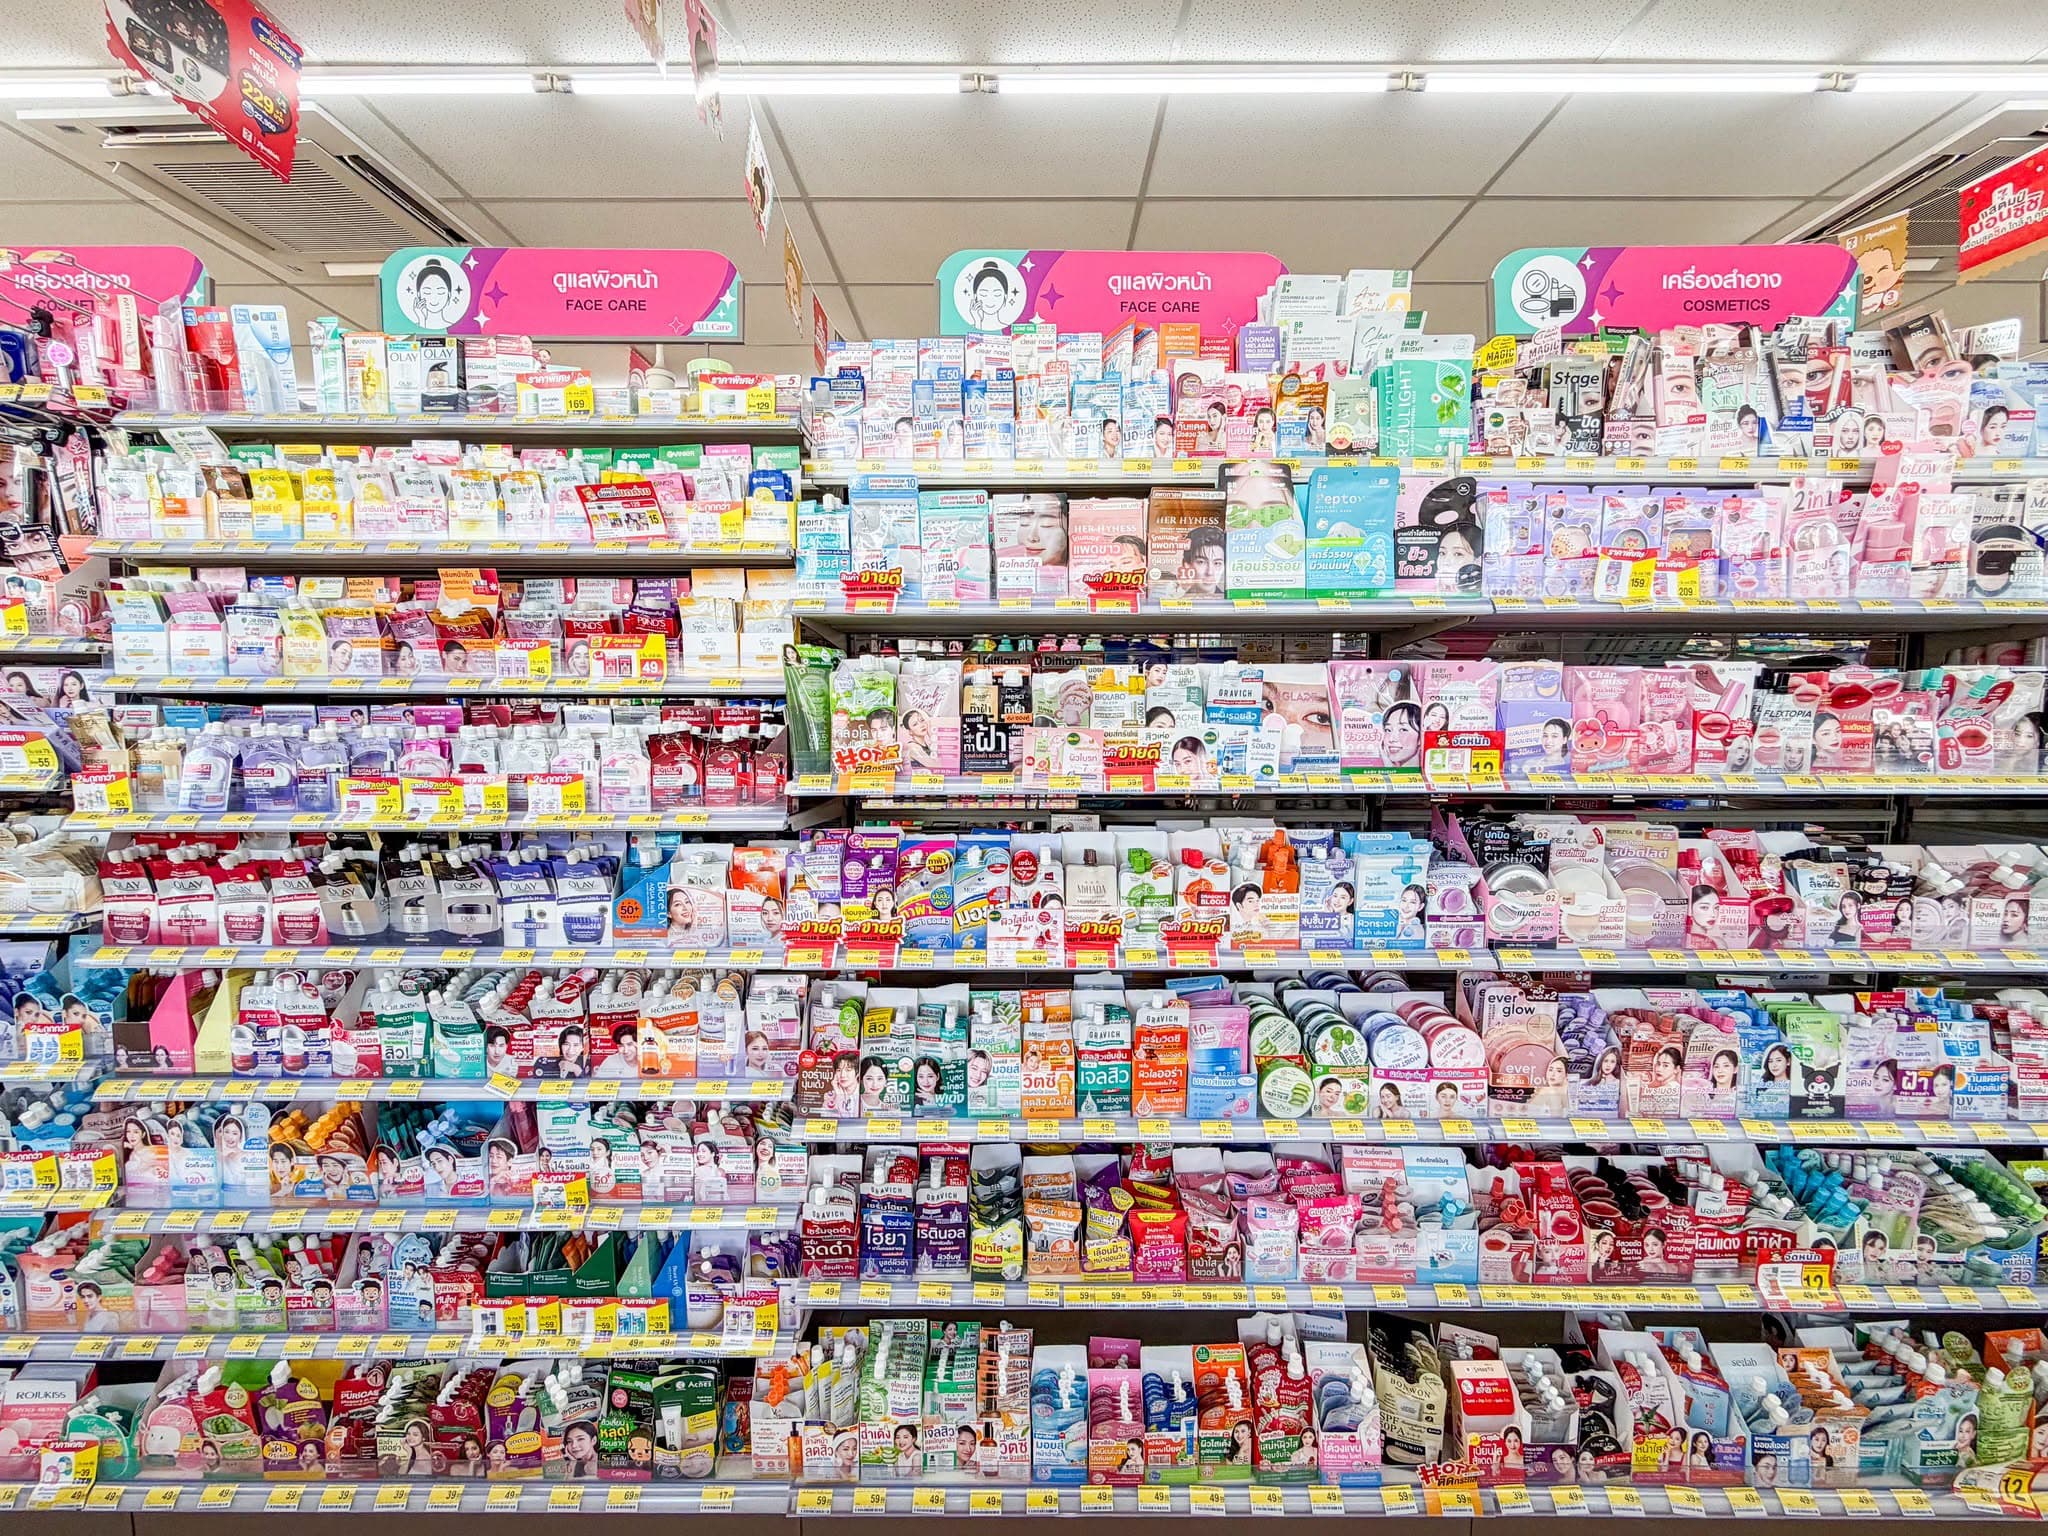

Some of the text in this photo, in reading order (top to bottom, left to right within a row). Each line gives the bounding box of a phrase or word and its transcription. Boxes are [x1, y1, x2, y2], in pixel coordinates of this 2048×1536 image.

[241, 79, 275, 114] 229
[553, 268, 658, 292] ดูแลผิวหน้า
[1662, 265, 1782, 290] เครื่องสำอาง
[1108, 271, 1212, 297] ดูแลผิวหน้า
[36, 300, 96, 313] COSMET
[566, 299, 647, 311] FACE CARE
[1120, 301, 1200, 313] FACE CARE
[1683, 299, 1770, 312] COSMETICS
[1911, 328, 1930, 337] PRO
[390, 352, 418, 362] OLAY
[423, 348, 454, 359] OLAY
[1486, 351, 1515, 361] MAGIC
[1853, 348, 1892, 359] Vegan
[1554, 372, 1600, 387] Stage
[918, 404, 932, 415] UV
[1901, 458, 1940, 475] GLOW
[906, 479, 916, 489] 10
[976, 495, 985, 505] 10
[1156, 516, 1219, 525] HER HYNESS
[860, 568, 902, 585] ขายดี
[1103, 569, 1145, 585] ขายดี
[1179, 568, 1195, 579] 10
[573, 622, 603, 630] POND'S
[637, 616, 665, 625] POND'S
[447, 625, 477, 633] POND'S
[1218, 688, 1252, 697] GRAVICH
[1118, 743, 1161, 760] ขายดี
[1556, 849, 1585, 858] cushion
[114, 880, 139, 890] OLAY
[173, 879, 203, 889] OLAY
[282, 879, 310, 888] OLAY
[400, 880, 427, 890] OLAY
[454, 881, 483, 890] OLAY
[510, 882, 537, 892] OLAY
[568, 880, 595, 890] OLAY
[620, 905, 639, 916] 50+
[658, 913, 667, 927] UV
[1324, 918, 1338, 929] 72
[801, 921, 842, 934] ขายดี
[862, 921, 902, 935] ขายดี
[1014, 924, 1023, 935] 7
[1181, 918, 1223, 935] ขายดี
[1488, 992, 1517, 1004] ever
[1502, 1004, 1535, 1017] glow
[1089, 1031, 1121, 1040] GRAVICH
[1506, 1063, 1536, 1075] ever
[1081, 1066, 1129, 1084] เจลสิว
[1956, 1096, 1973, 1106] UV
[870, 1185, 902, 1193] GRAVICH
[1314, 1185, 1335, 1193] MILK
[926, 1192, 958, 1201] GRAVICH
[813, 1210, 844, 1218] GRAVICH
[866, 1226, 906, 1246] ไฮยา
[1390, 1377, 1431, 1399] BONWON
